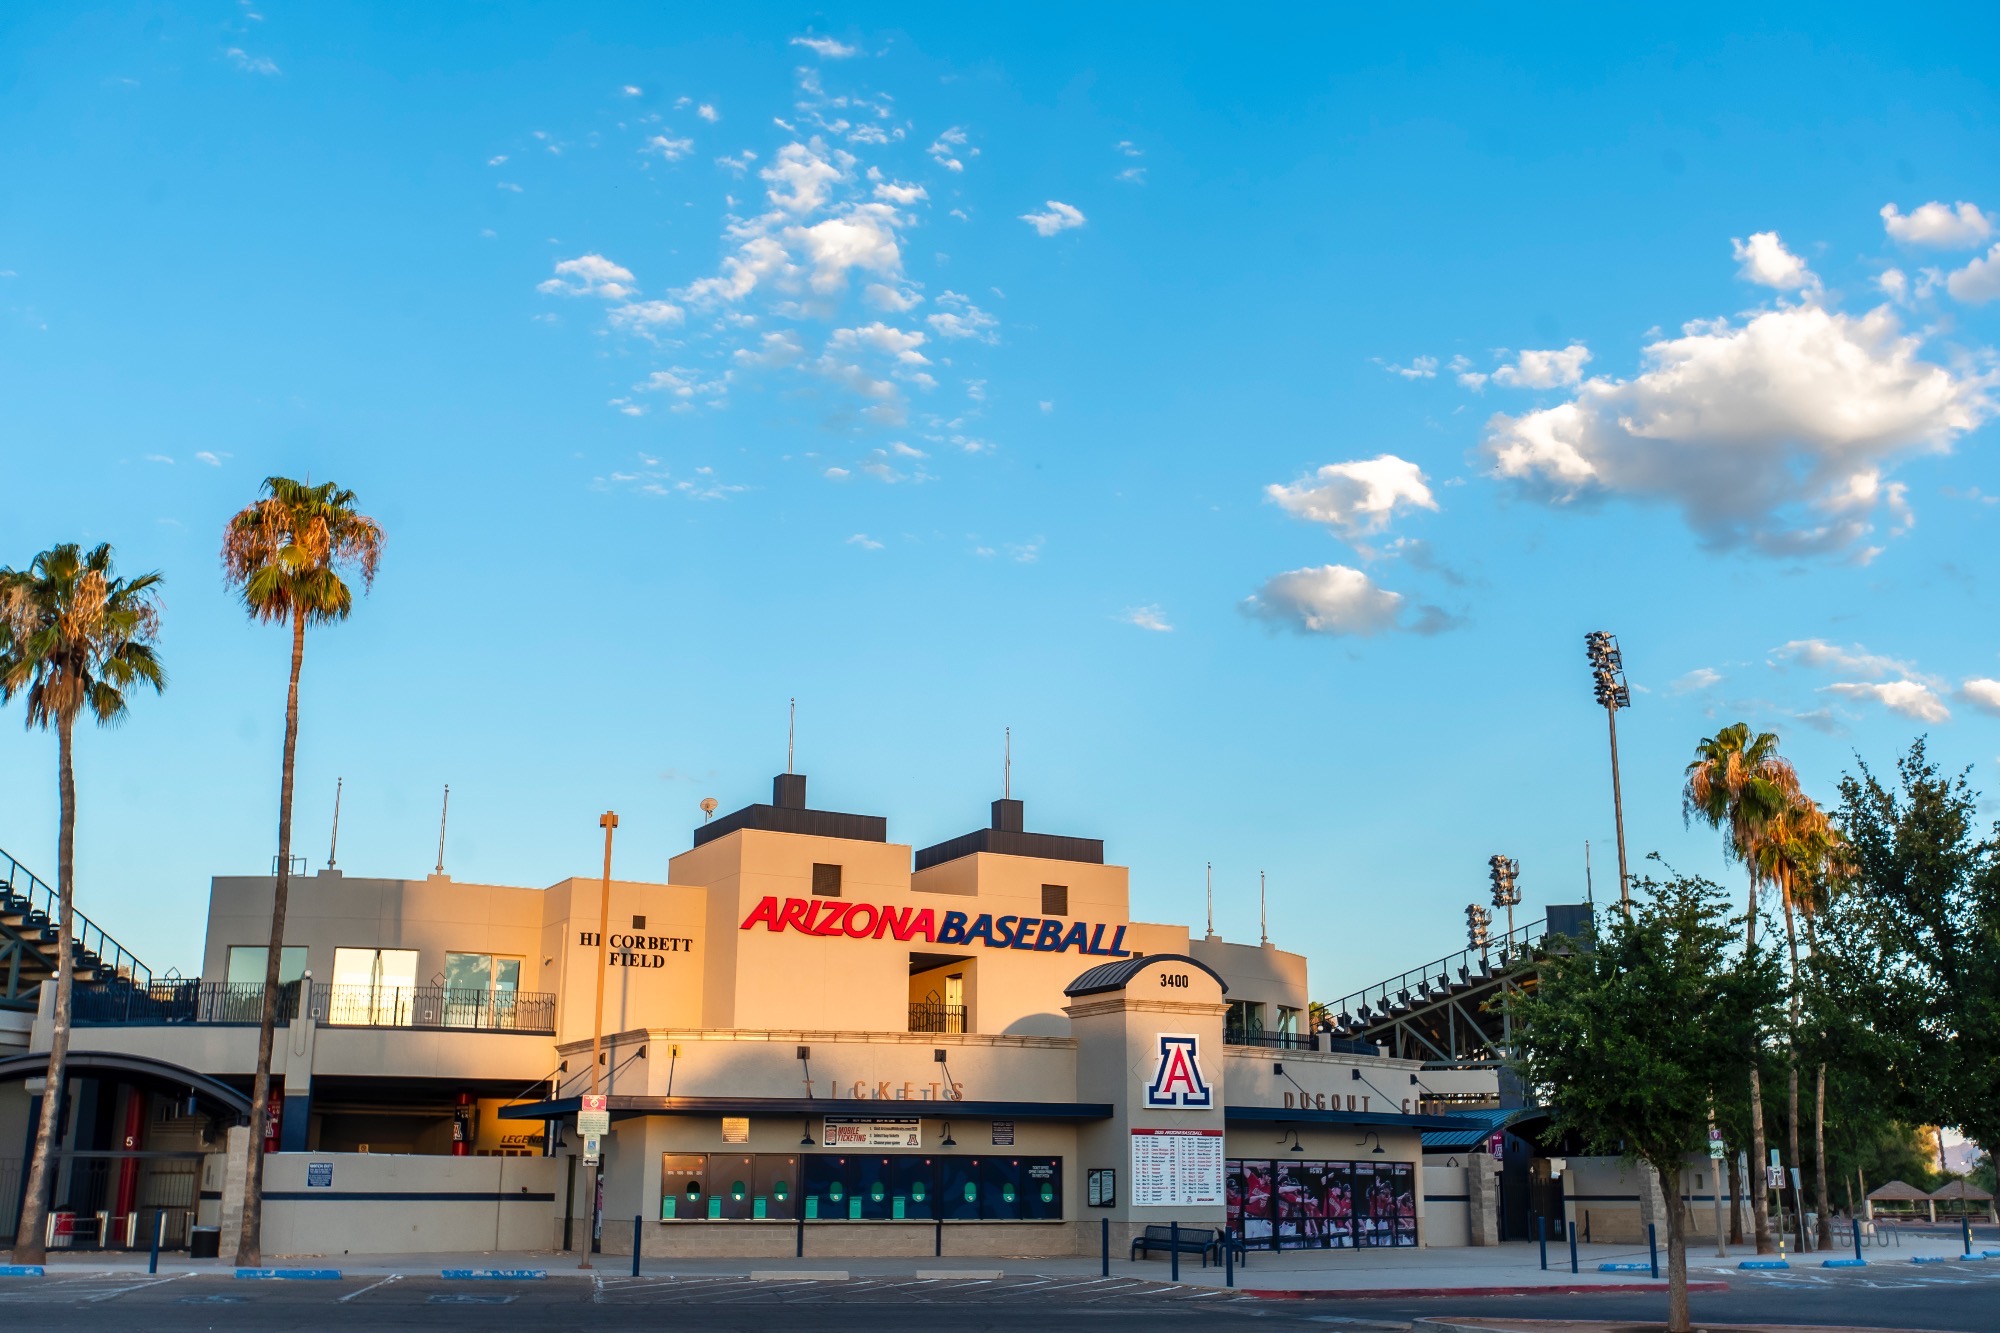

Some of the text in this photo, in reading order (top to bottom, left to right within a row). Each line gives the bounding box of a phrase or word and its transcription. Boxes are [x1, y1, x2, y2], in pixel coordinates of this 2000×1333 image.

[739, 896, 1130, 957] ARIZONA BASEBALL
[609, 934, 693, 952] CORBETT
[608, 952, 665, 968] FIELD
[1160, 974, 1189, 988] 3400
[1148, 1036, 1210, 1106] A
[802, 1080, 963, 1101] TICKETS
[1284, 1092, 1370, 1113] DUGOUT
[838, 1127, 860, 1135] MOBILE
[838, 1134, 867, 1142] TICKETING
[126, 1137, 133, 1147] 5
